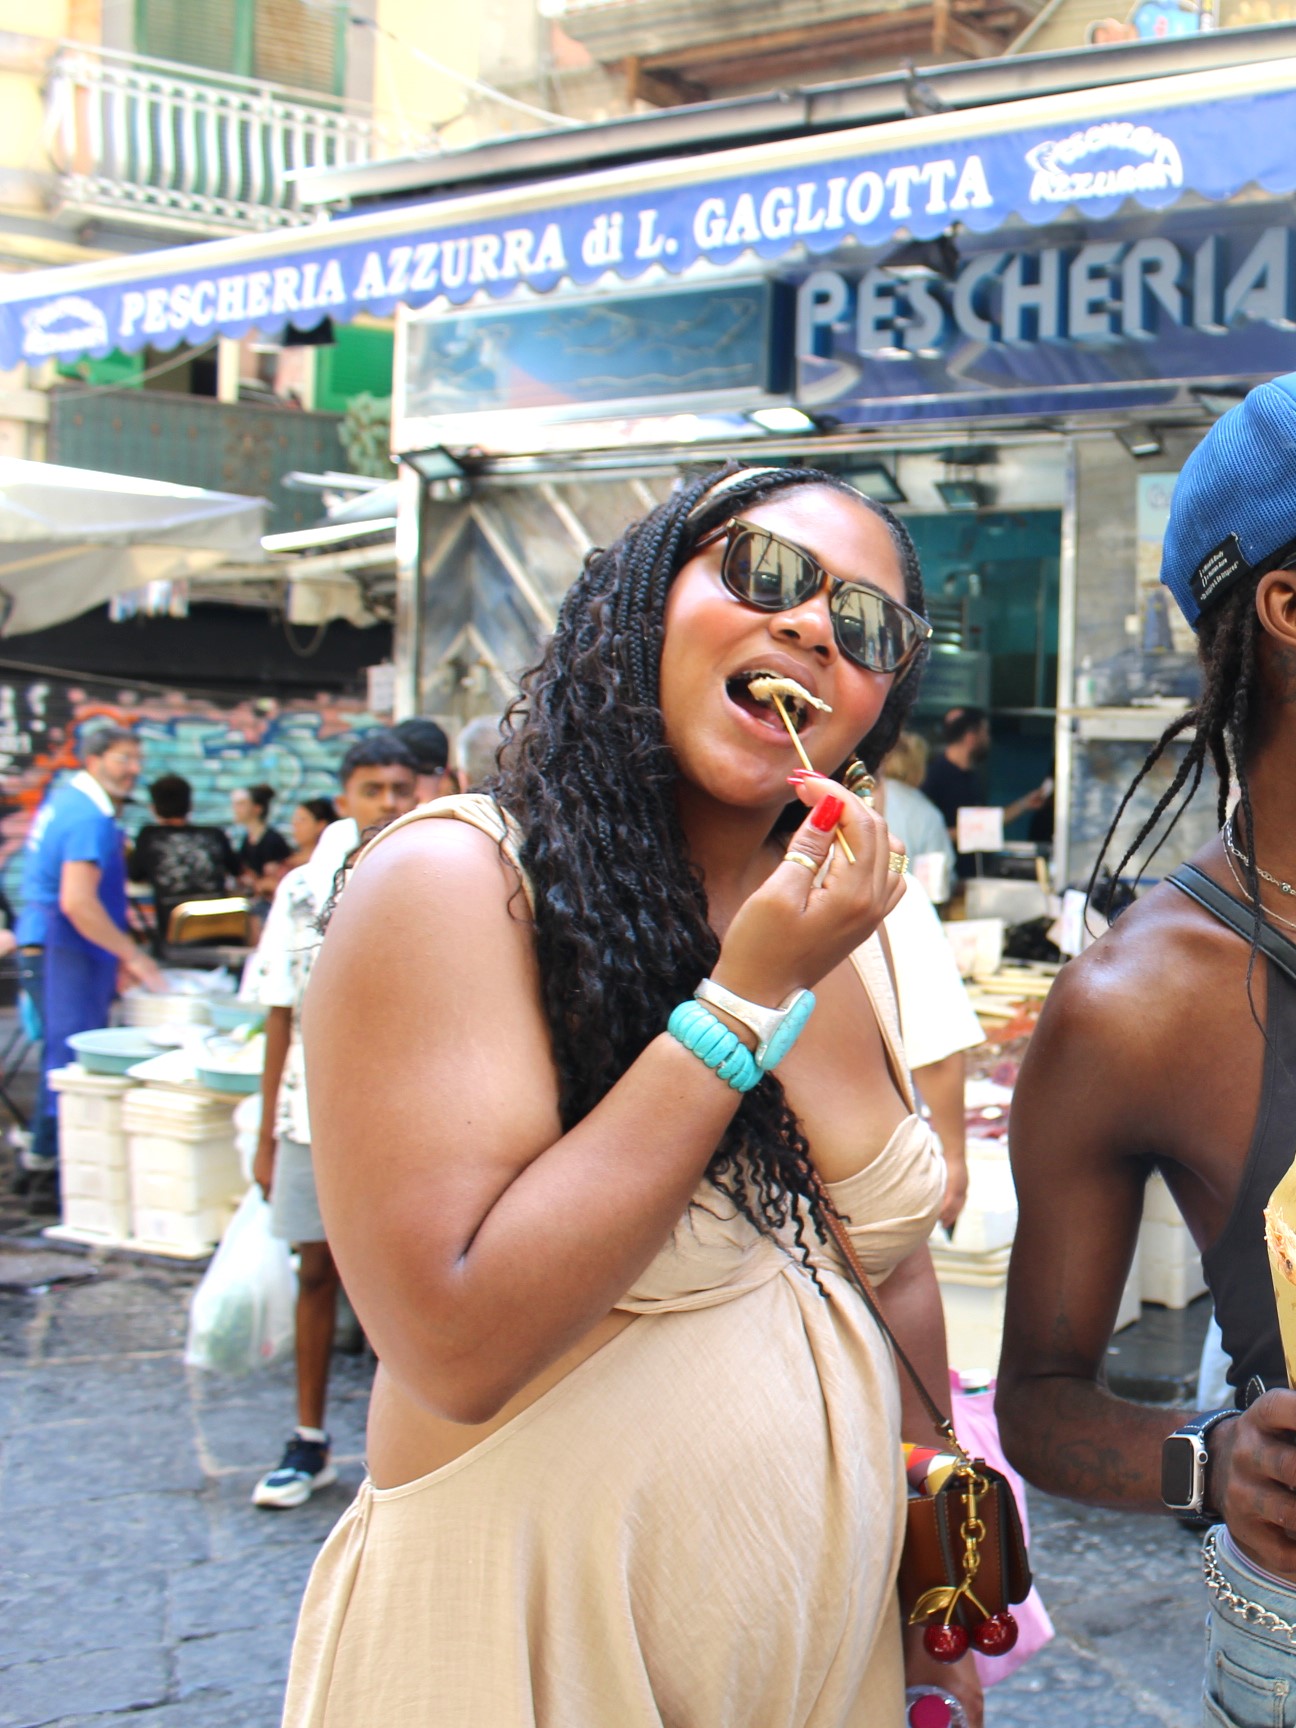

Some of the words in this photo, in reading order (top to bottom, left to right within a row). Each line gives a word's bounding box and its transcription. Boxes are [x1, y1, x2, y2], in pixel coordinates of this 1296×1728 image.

[119, 257, 345, 337] PESCHERIA
[354, 224, 566, 299] AZZURRA
[581, 212, 623, 267] di
[637, 208, 679, 253] L.
[693, 154, 994, 249] GAGLIOTTA
